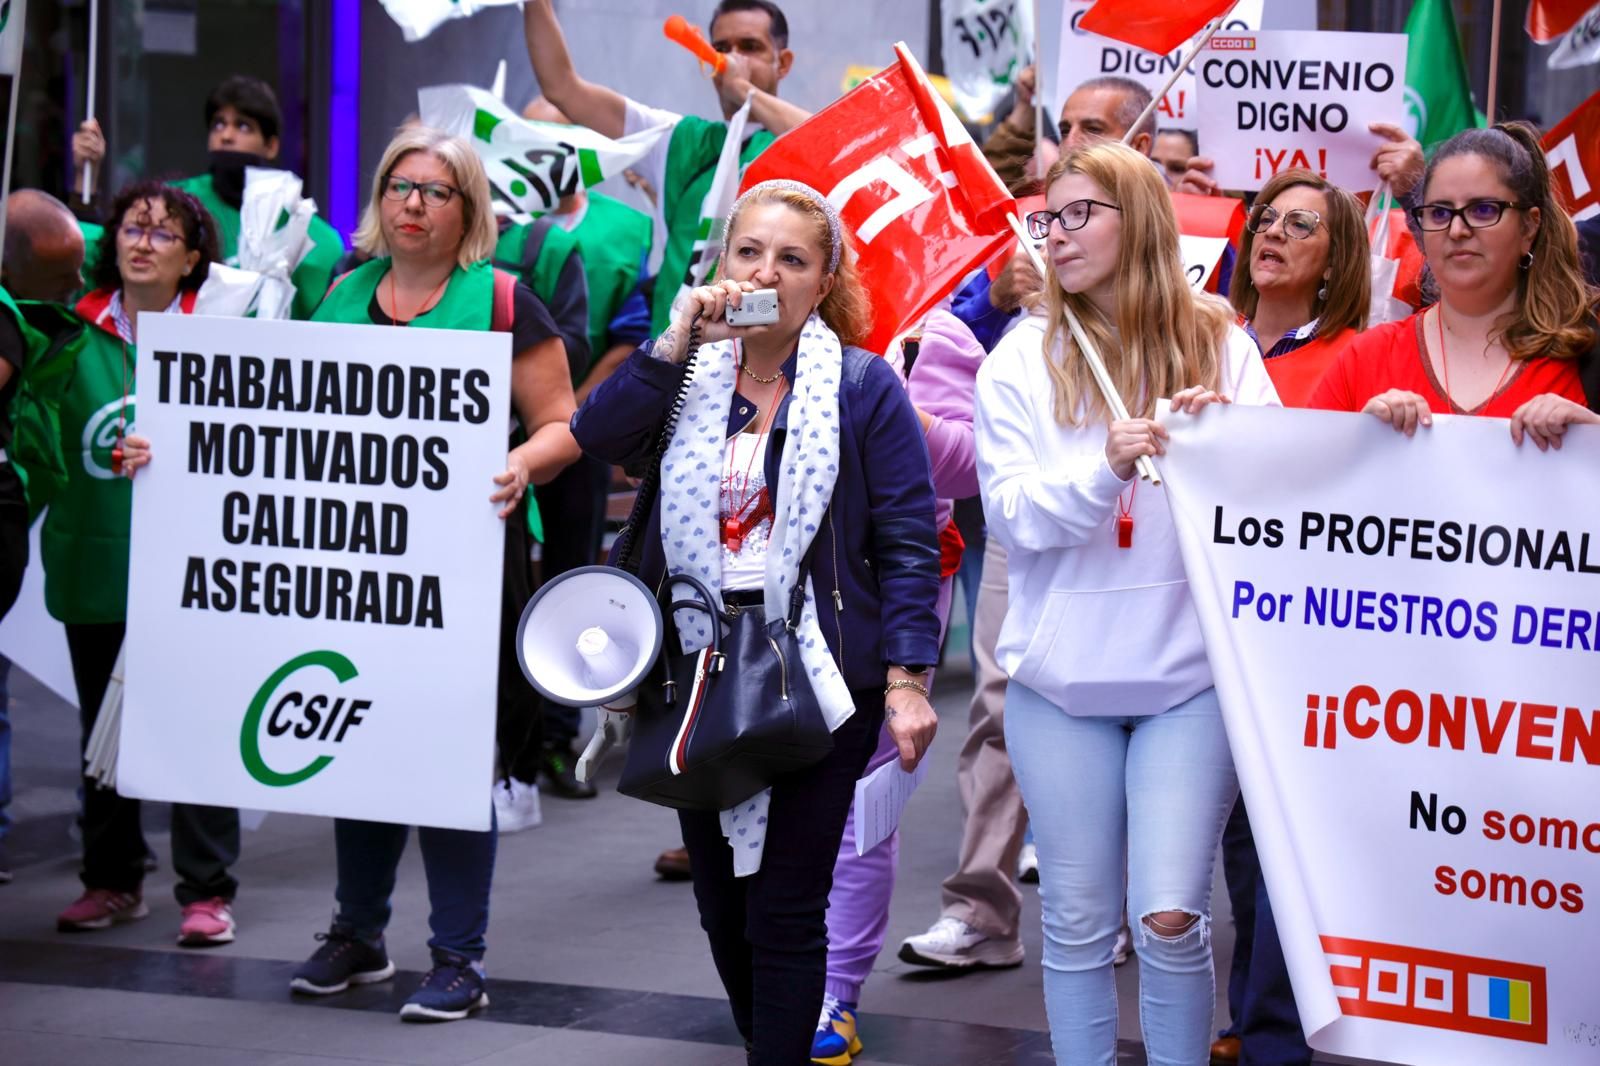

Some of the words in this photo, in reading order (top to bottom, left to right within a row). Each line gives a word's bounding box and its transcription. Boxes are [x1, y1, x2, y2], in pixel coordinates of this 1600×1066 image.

[1100, 47, 1196, 75] DIGN
[1212, 38, 1242, 49] CCOO
[1203, 58, 1394, 93] CONVENIO
[1237, 101, 1348, 133] DIGNO
[1255, 148, 1327, 180] ¡YA!
[153, 350, 490, 425] TRABAJADORES
[188, 421, 449, 491] MOTIVADOS
[222, 491, 409, 556] CALIDAD
[1213, 505, 1284, 549] Los
[1299, 511, 1600, 574] PROFESIONAL
[181, 556, 444, 629] ASEGURADA
[1232, 580, 1293, 623] Por
[1304, 586, 1498, 642] NUESTROS
[1511, 604, 1600, 652] DER
[267, 690, 373, 743] CSIF
[1409, 790, 1467, 836] No
[1434, 865, 1584, 914] somos
